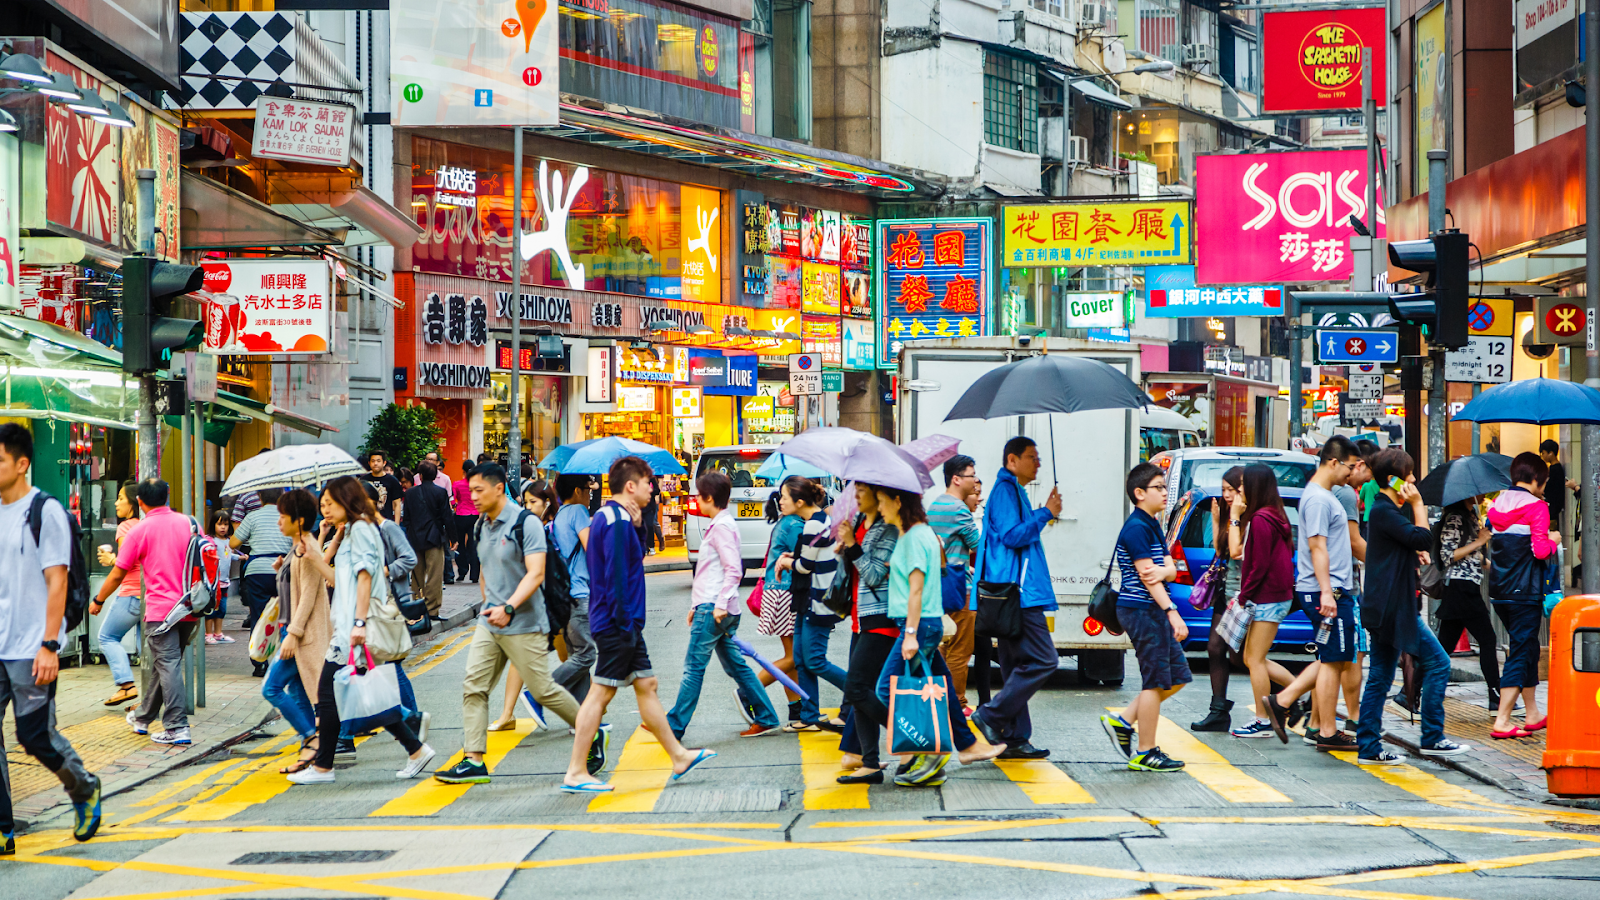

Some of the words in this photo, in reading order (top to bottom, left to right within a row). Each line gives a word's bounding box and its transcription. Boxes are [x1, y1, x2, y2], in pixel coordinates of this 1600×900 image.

[1525, 12, 1536, 30] Shop
[1316, 26, 1344, 44] THE
[1303, 43, 1360, 66] SPAGHETTI
[1314, 66, 1352, 86] HOUSE
[1317, 91, 1332, 99] Since
[265, 101, 346, 123] 金樂芬蘭館
[262, 117, 284, 130] KAM
[290, 121, 308, 133] LOK
[314, 123, 344, 137] SAUNA
[266, 130, 340, 146] きんらくよくじょう
[437, 165, 476, 193] 大快活
[437, 191, 476, 207] Fairwood
[745, 204, 769, 227] 京都
[1011, 208, 1168, 244] 花園餐廳
[887, 230, 966, 269] 花園
[1013, 248, 1071, 262] 金百利商場
[1075, 248, 1094, 261] 4/F
[1279, 232, 1344, 272] 莎莎
[683, 261, 704, 276] 大快活
[260, 274, 307, 290] 順興隆
[244, 294, 322, 310] 汽水士多店
[896, 273, 979, 313] 餐廳
[1168, 287, 1280, 306] 銀河中西大藥
[592, 303, 622, 328] 吉野家
[1070, 297, 1114, 317] Cover
[208, 306, 224, 347] Coca-Cola
[423, 292, 487, 347] 吉野家
[888, 317, 978, 338] 牛扒之家
[1487, 341, 1506, 355] 12
[420, 362, 491, 388] YOSHINOYA
[636, 371, 674, 381] DISPENSARY
[1487, 364, 1504, 377] 12
[796, 383, 815, 392] 全日
[1371, 376, 1381, 385] 12
[1370, 389, 1381, 397] 12
[1079, 576, 1099, 584] 2760
[897, 716, 929, 747] SATAMI
